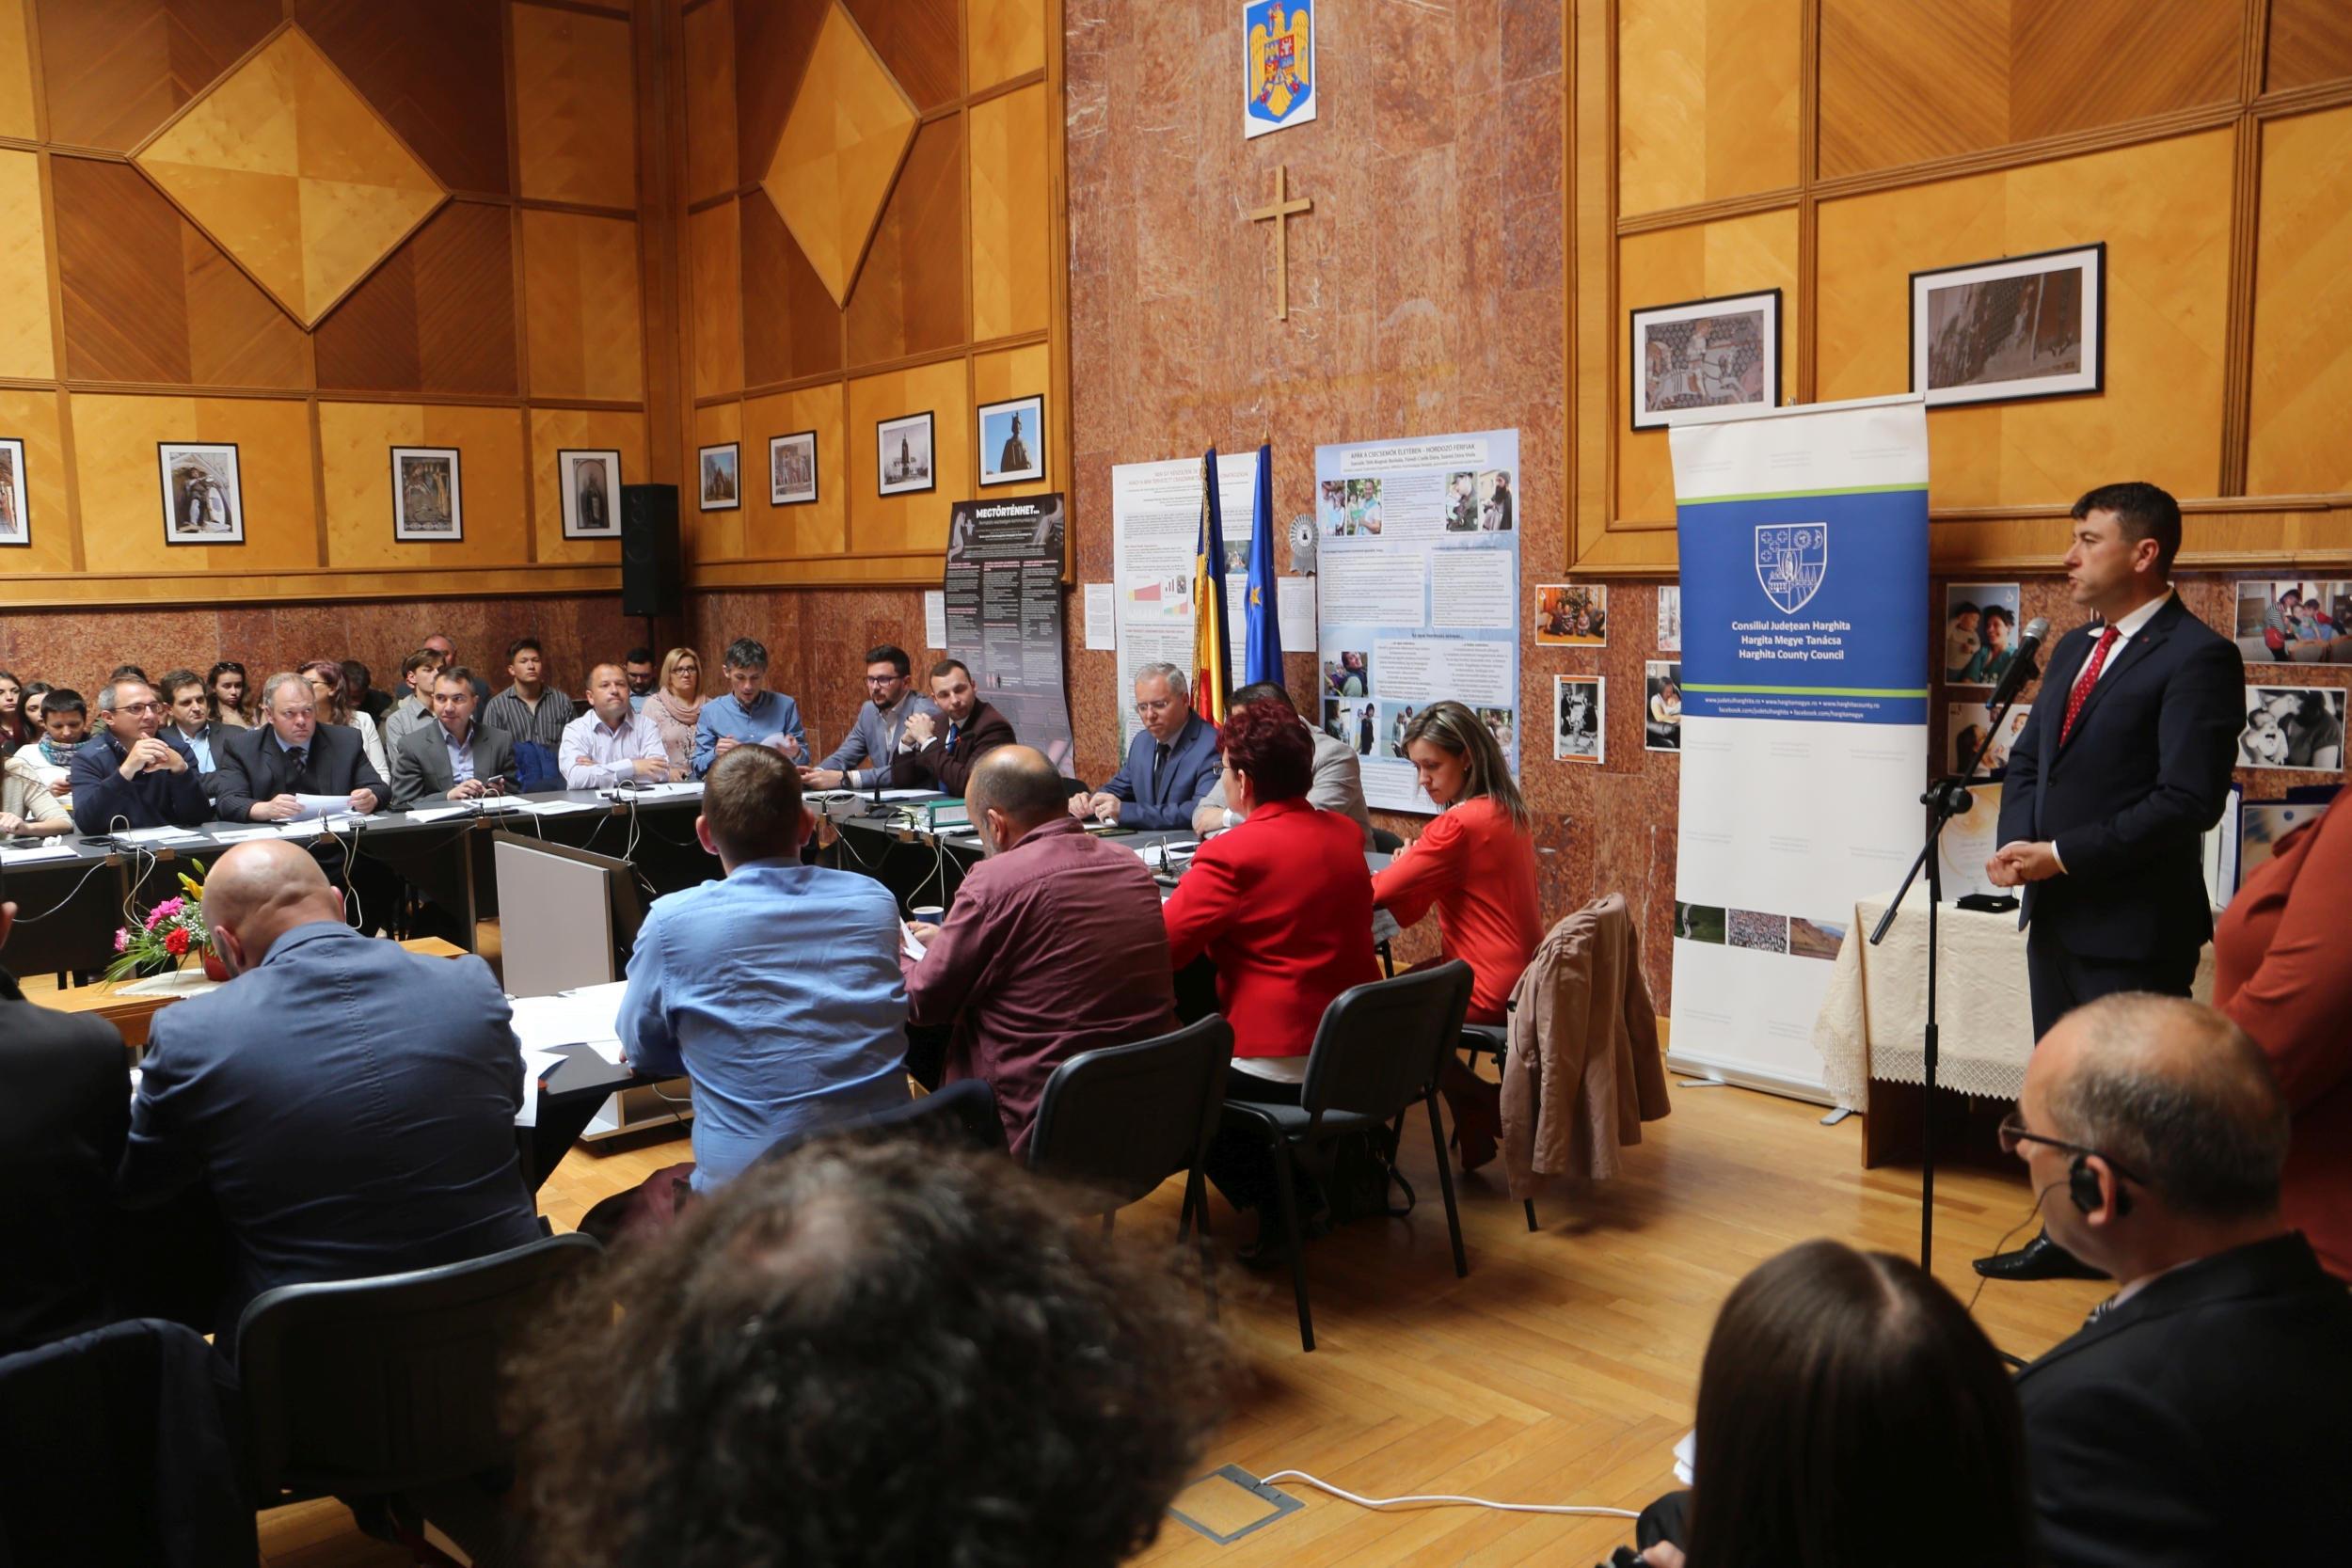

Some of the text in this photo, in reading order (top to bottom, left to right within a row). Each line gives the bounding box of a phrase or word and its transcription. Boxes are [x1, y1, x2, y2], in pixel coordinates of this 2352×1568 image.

[1732, 620, 1769, 631] Consiliul
[1813, 620, 1851, 633] Harghita
[1741, 634, 1842, 647] Hargita Megye Tanácsa
[1739, 648, 1845, 661] Harghita County Council
[1718, 706, 1789, 716] facebook.com/judetulharghita
